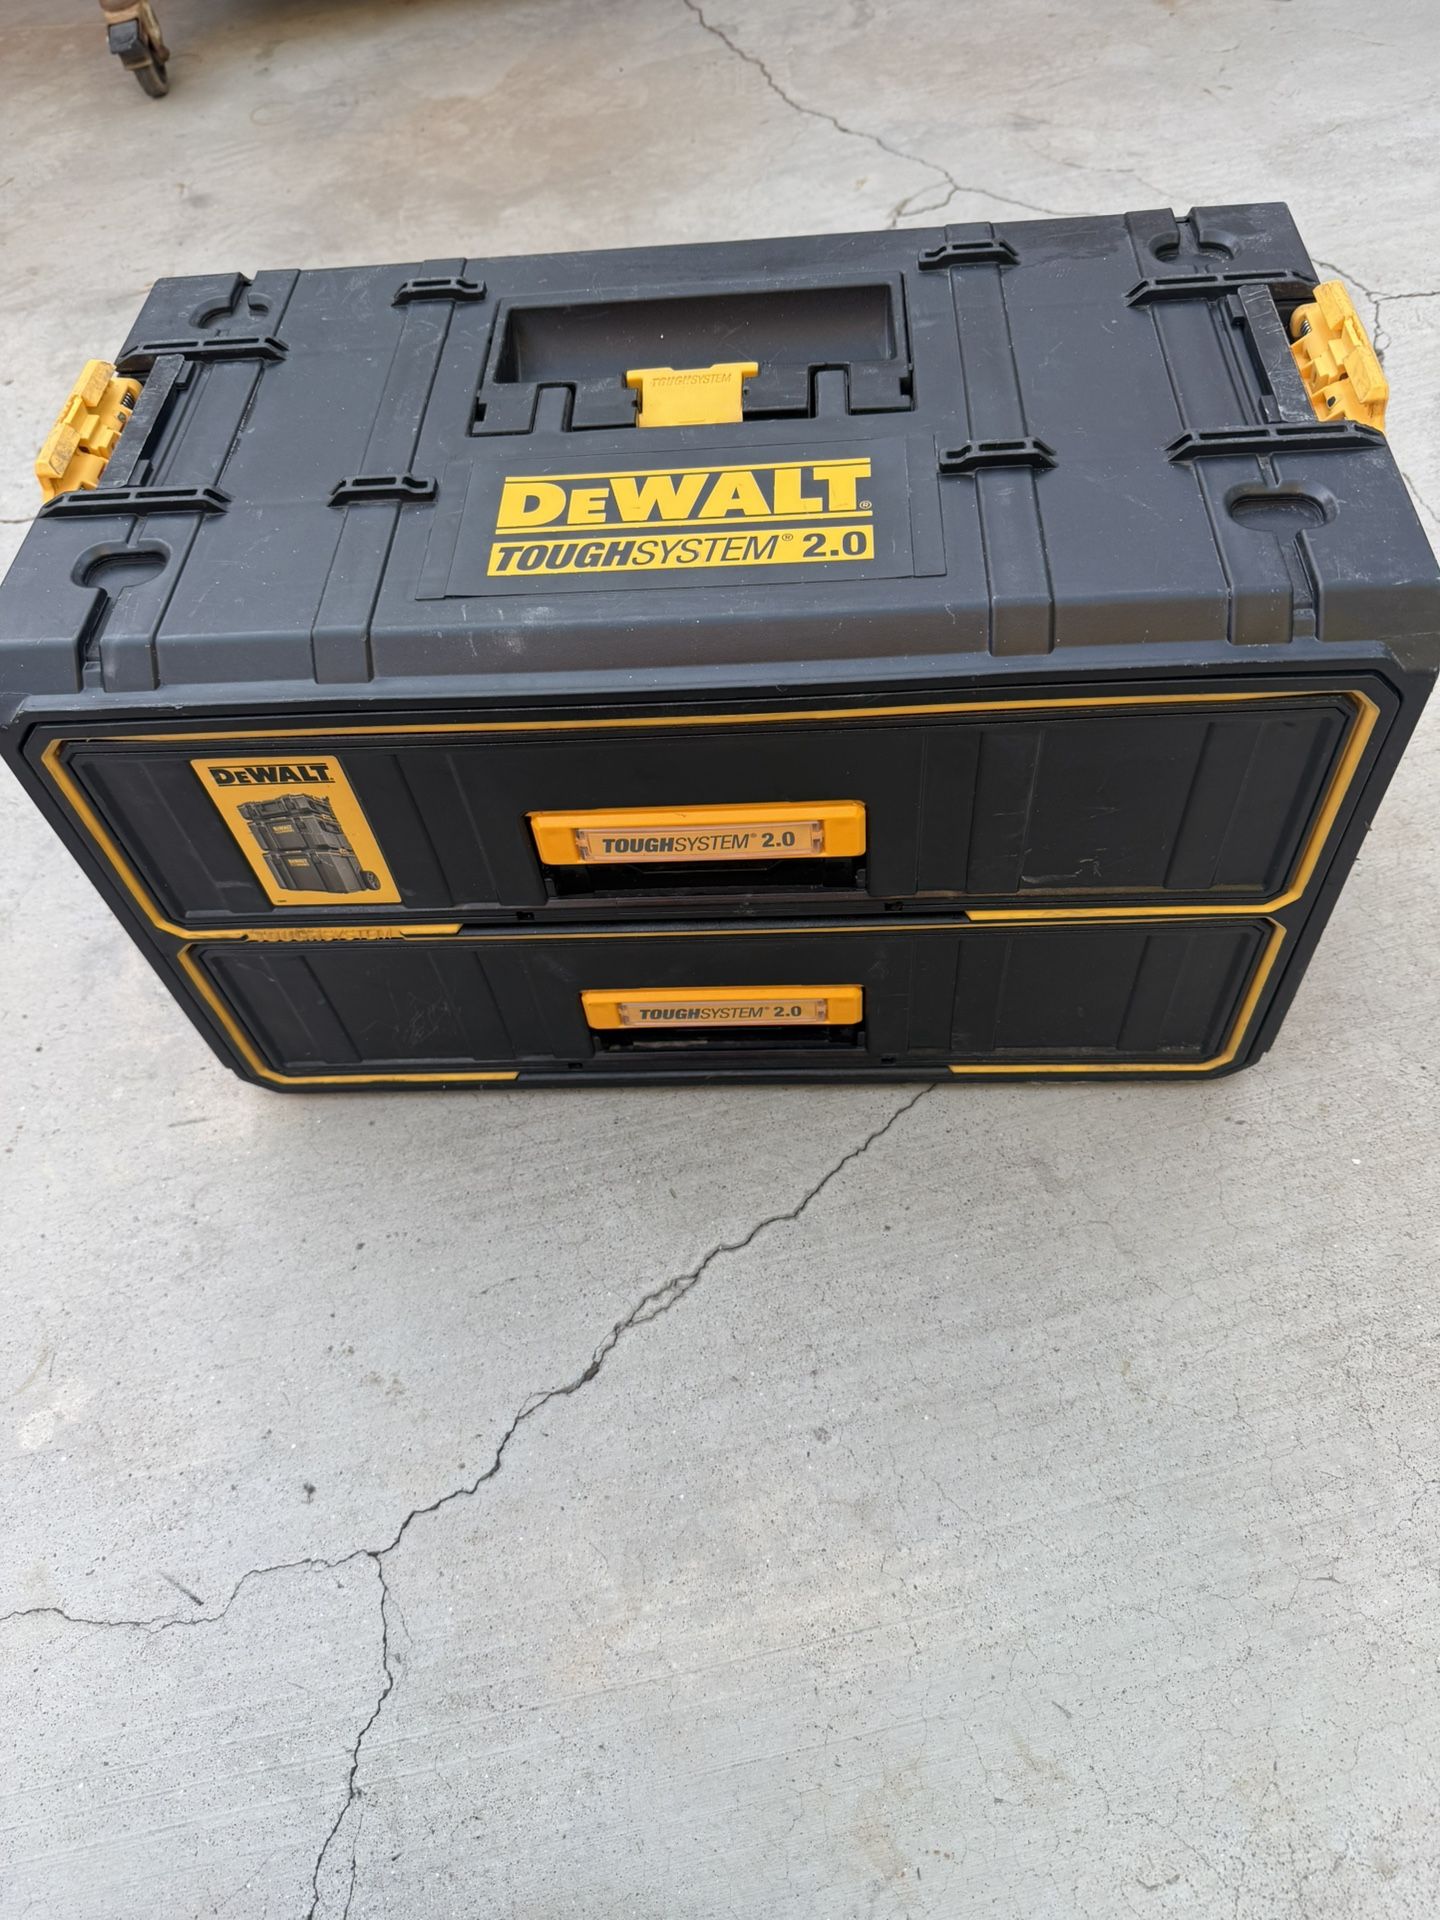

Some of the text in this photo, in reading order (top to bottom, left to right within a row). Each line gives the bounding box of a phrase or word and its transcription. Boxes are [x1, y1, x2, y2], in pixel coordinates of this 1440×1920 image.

[803, 531, 867, 558] 2.0
[761, 831, 796, 848] 2.0
[774, 1006, 802, 1017] 2.0
